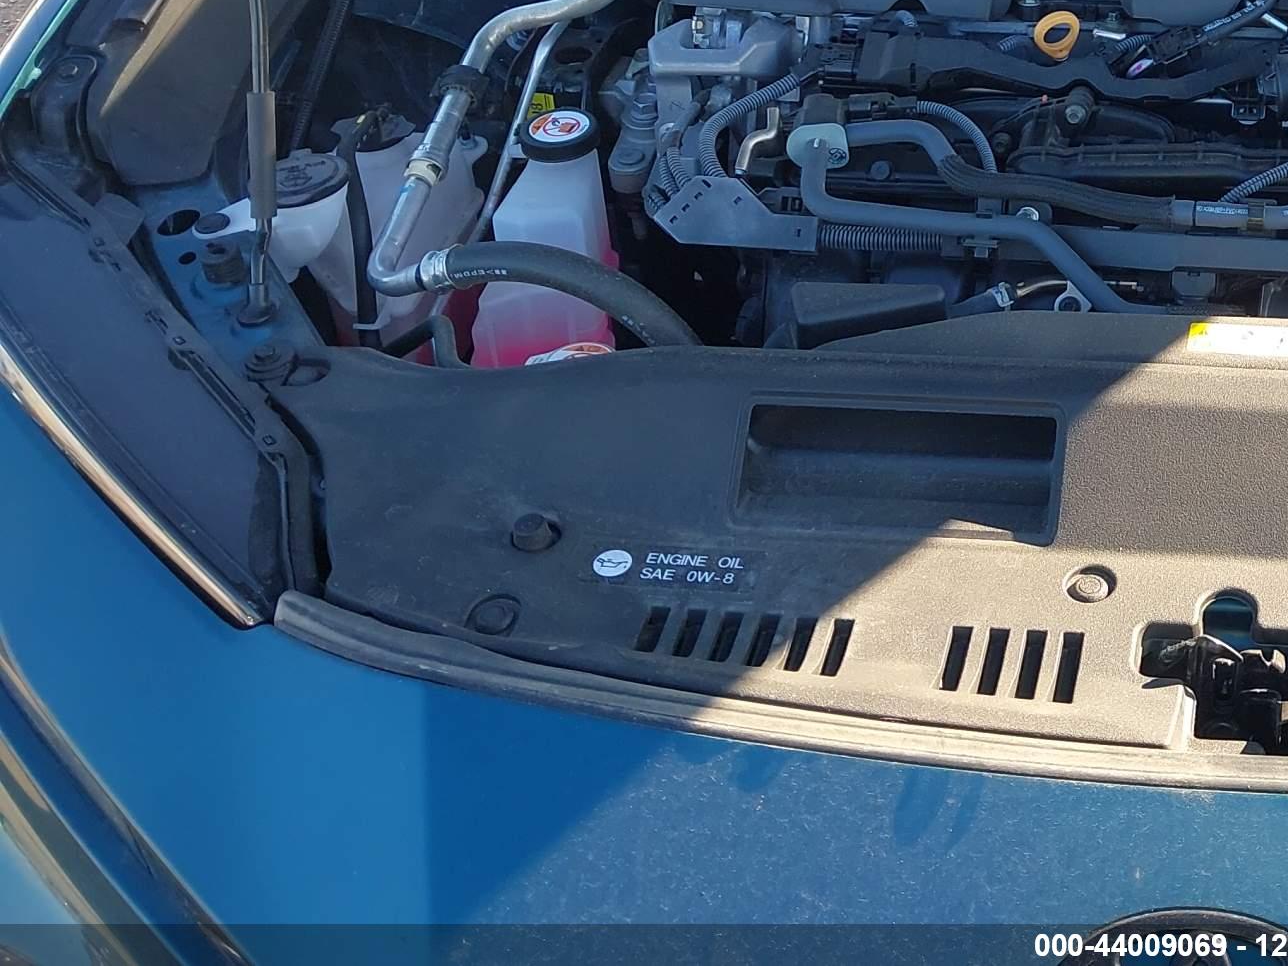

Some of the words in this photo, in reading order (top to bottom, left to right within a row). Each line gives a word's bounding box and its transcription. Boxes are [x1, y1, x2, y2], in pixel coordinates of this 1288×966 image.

[646, 552, 708, 566] ENGINE
[718, 556, 744, 569] OIL
[640, 567, 676, 581] SAE
[686, 570, 734, 584] 0W-8
